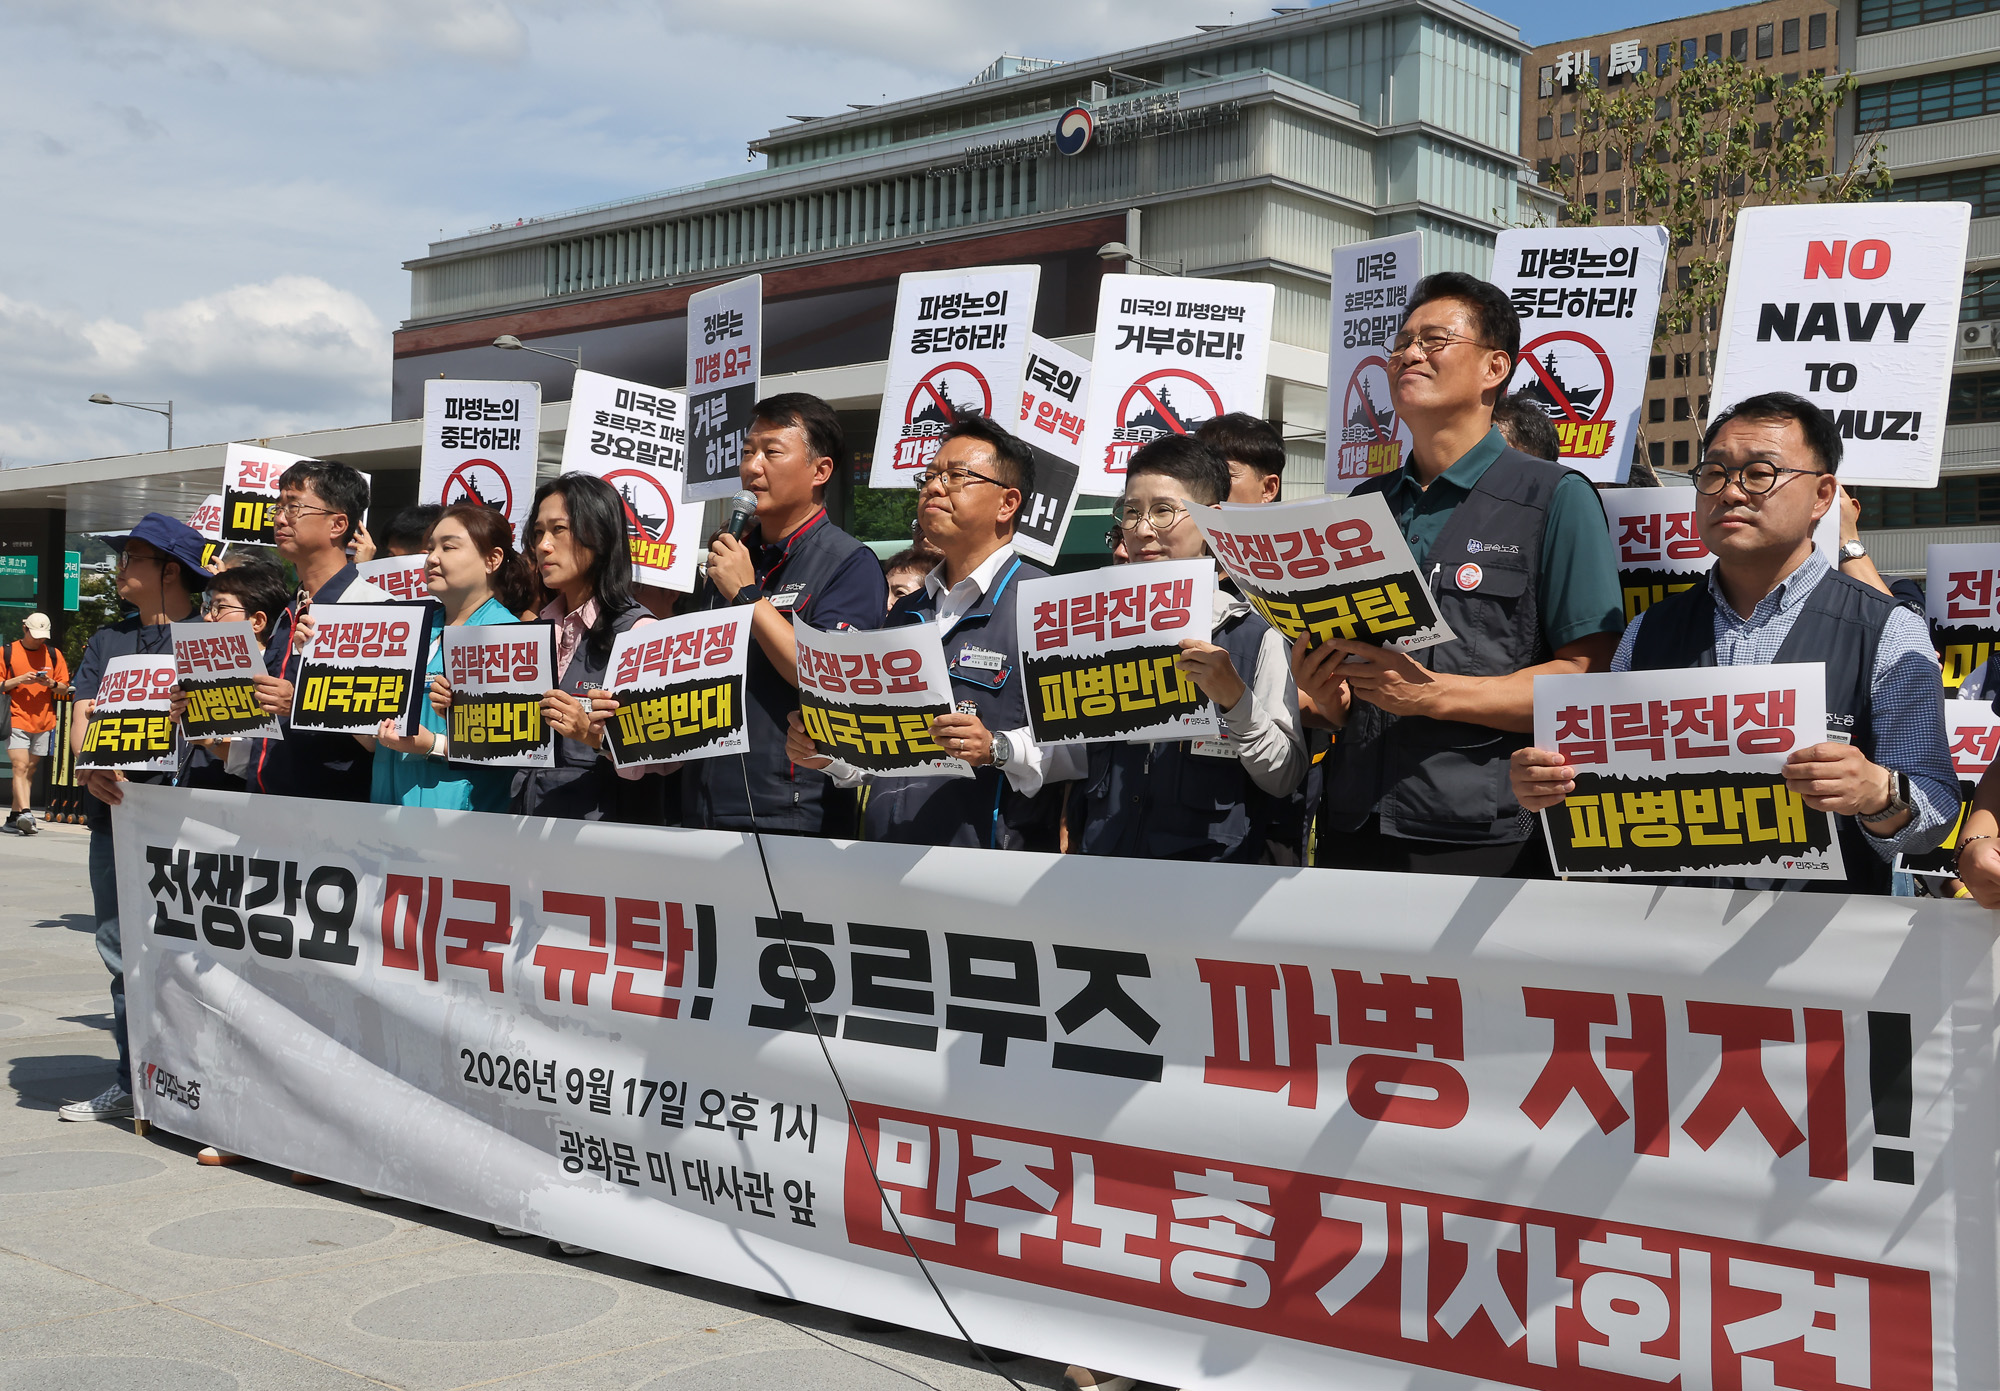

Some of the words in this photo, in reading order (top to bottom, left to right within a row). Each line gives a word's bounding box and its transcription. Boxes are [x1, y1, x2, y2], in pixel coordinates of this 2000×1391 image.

[1357, 251, 1397, 283] 미국은
[1517, 247, 1639, 279] 파병논의
[1803, 238, 1892, 280] NO
[918, 290, 1008, 321] 파병논의
[1120, 298, 1172, 317] 미국의
[1175, 302, 1246, 323] 파병압박
[1344, 288, 1384, 312] 호르무즈
[1386, 284, 1407, 307] 파병
[1511, 287, 1637, 319] 중단하라!
[704, 309, 743, 345] 정부는
[911, 324, 1008, 355] 중단하라!
[1756, 302, 1927, 343] NAVY
[1115, 324, 1245, 361] 거부하라!
[695, 351, 720, 385] 파병
[723, 345, 751, 379] 요구
[1805, 362, 1858, 393] TO
[444, 397, 520, 422] 파병논의
[593, 410, 656, 437] 호르무즈
[615, 388, 676, 421] 미국은
[693, 392, 728, 438] 거부
[1034, 401, 1085, 446] 압박
[440, 425, 521, 451] 중단하라!
[705, 427, 747, 476] 하라
[1342, 427, 1369, 443] 호르무즈
[1206, 518, 1386, 581] 전쟁강요
[1484, 543, 1519, 554] 금속노조
[1033, 578, 1194, 652] 침략전쟁
[175, 635, 252, 674] 침략전쟁
[313, 621, 410, 659] 전쟁강요
[614, 621, 738, 687] 침략전쟁
[451, 641, 539, 685] 침략전쟁
[797, 640, 928, 695] 전쟁강요
[96, 668, 176, 706] 전쟁강요
[302, 675, 404, 713] 미국규탄
[1038, 653, 1197, 722] 파병반대
[453, 701, 541, 744] 파병반대
[614, 683, 732, 746] 파병반대
[801, 704, 945, 755] 미국규탄
[1554, 688, 1796, 766] 침략전쟁
[82, 717, 172, 752] 미국규탄
[1564, 784, 1808, 849] 파병반대
[1796, 861, 1829, 870] 민주노총
[146, 846, 360, 966] 전쟁강요
[381, 873, 513, 994] 미국
[532, 890, 719, 1021] 규탄!
[748, 910, 1164, 1083] 호르무즈
[1195, 957, 1469, 1129] 파병
[1518, 985, 1915, 1186] 저지!
[156, 1068, 201, 1110] 민주노총
[460, 1048, 557, 1104] 2026년
[566, 1067, 614, 1115] 9월
[623, 1077, 687, 1129] 17일
[694, 1088, 760, 1140] 오후
[770, 1102, 818, 1153] 1시
[559, 1129, 640, 1187] 광화문
[646, 1151, 677, 1196] 미
[682, 1158, 776, 1219] 대사관
[783, 1179, 816, 1228] 앞
[877, 1117, 1277, 1309] 민주노총
[1314, 1191, 1871, 1391] 기자회견
